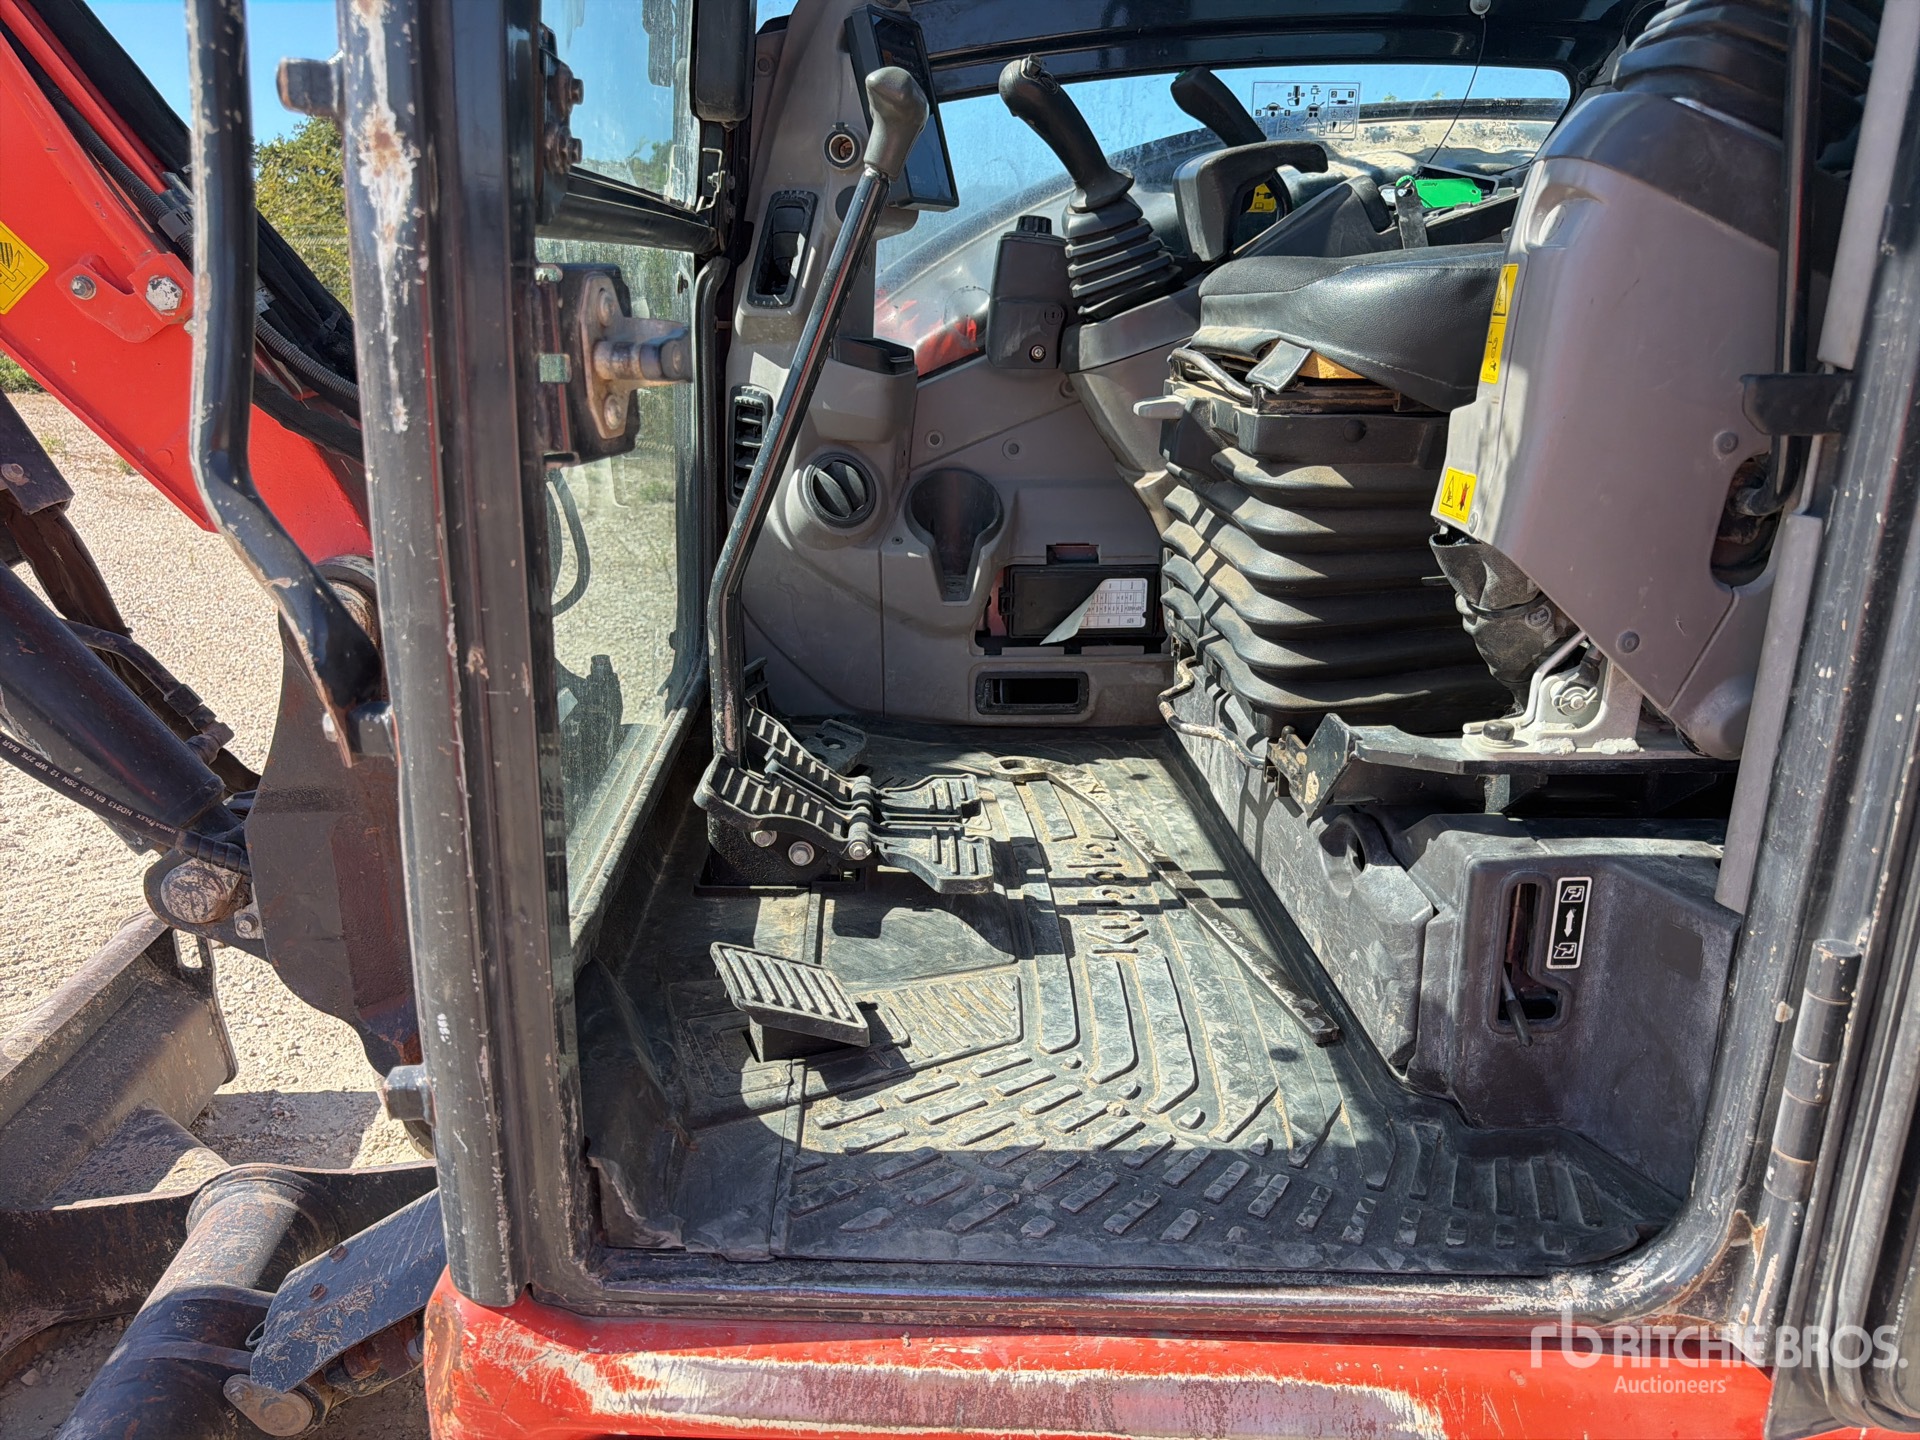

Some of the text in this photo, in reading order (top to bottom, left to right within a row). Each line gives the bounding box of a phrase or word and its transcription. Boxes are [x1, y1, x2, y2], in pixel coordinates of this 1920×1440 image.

[2, 739, 21, 754] BAR
[21, 753, 36, 764] 275
[34, 761, 49, 772] WP
[49, 770, 60, 778] 12
[61, 776, 78, 788] 2SN
[79, 787, 95, 797] 853
[94, 793, 106, 803] EN
[108, 800, 133, 816] HD213
